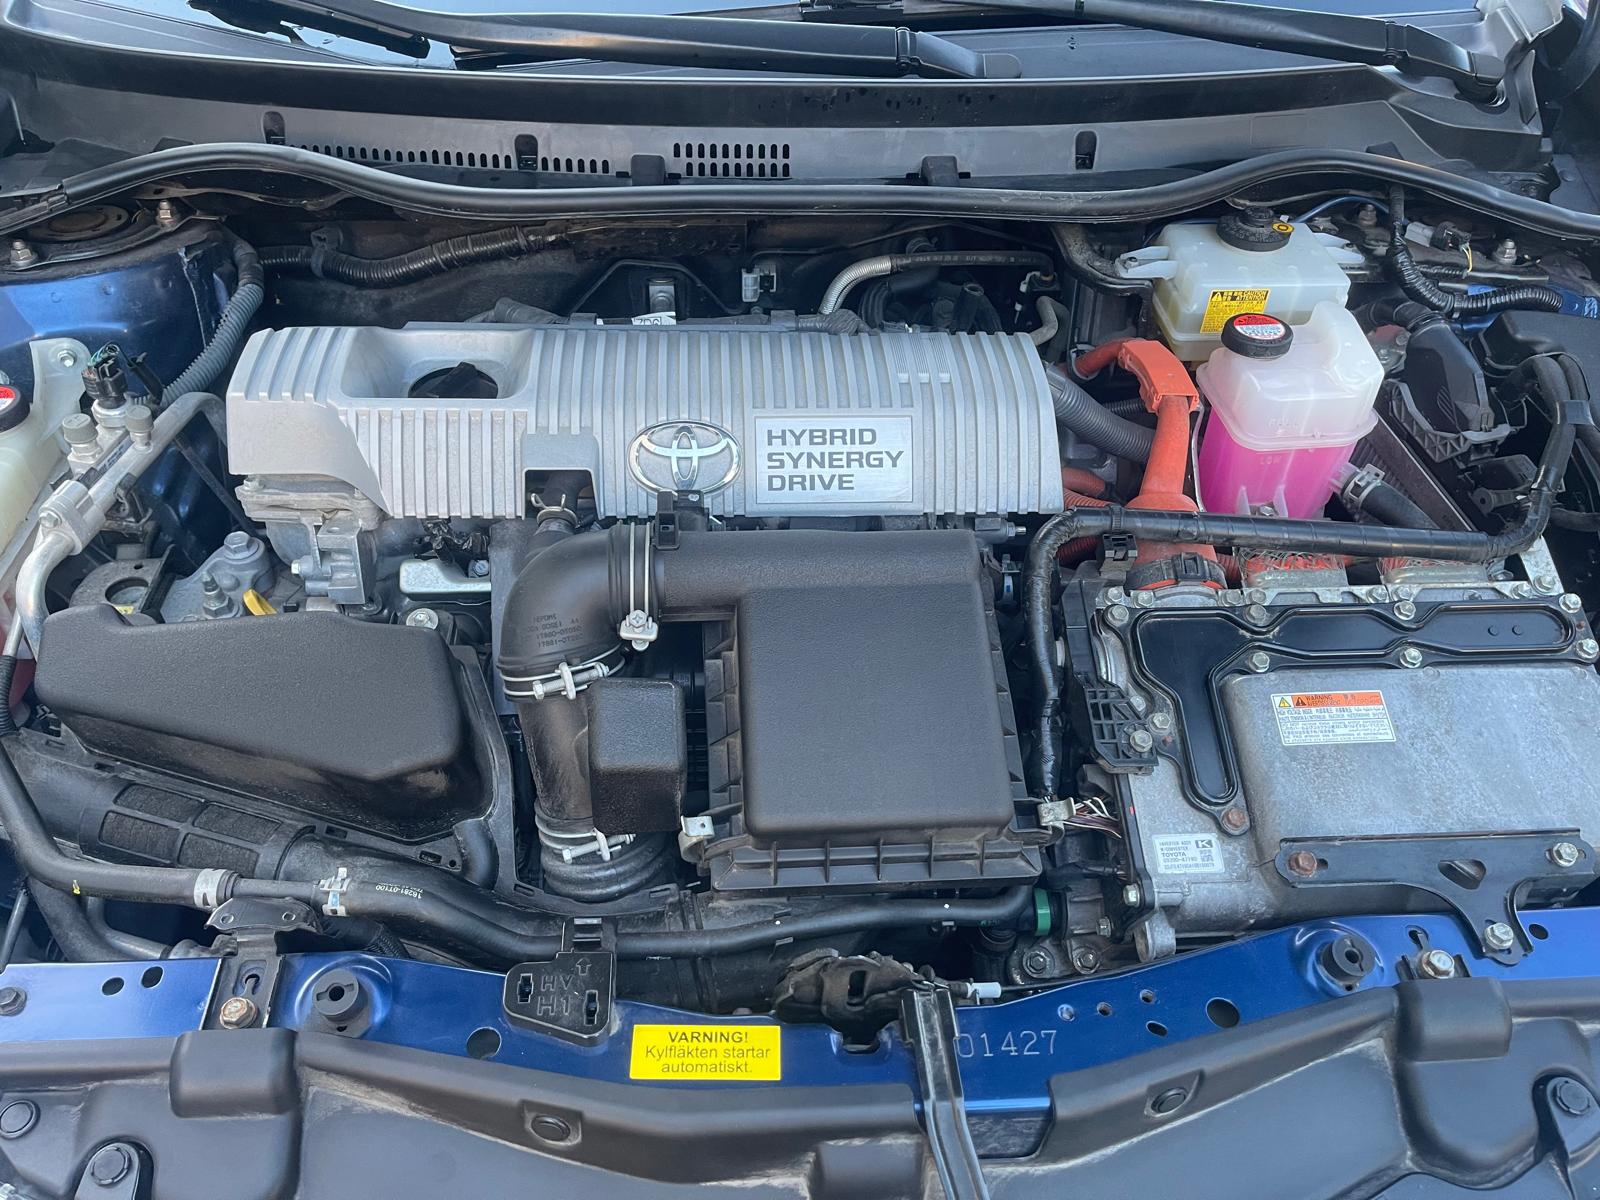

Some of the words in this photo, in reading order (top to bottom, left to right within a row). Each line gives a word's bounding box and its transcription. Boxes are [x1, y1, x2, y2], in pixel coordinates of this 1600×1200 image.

[767, 428, 877, 446] HYBRID
[767, 450, 904, 469] SYNERGY
[767, 474, 855, 491] DRIVE
[541, 975, 574, 992] HV
[668, 1031, 749, 1043] VARNING!
[957, 1030, 1057, 1057] 01427
[645, 1045, 718, 1061] Kylfläkten
[723, 1046, 771, 1058] startar
[661, 1061, 753, 1073] automatiskt.
